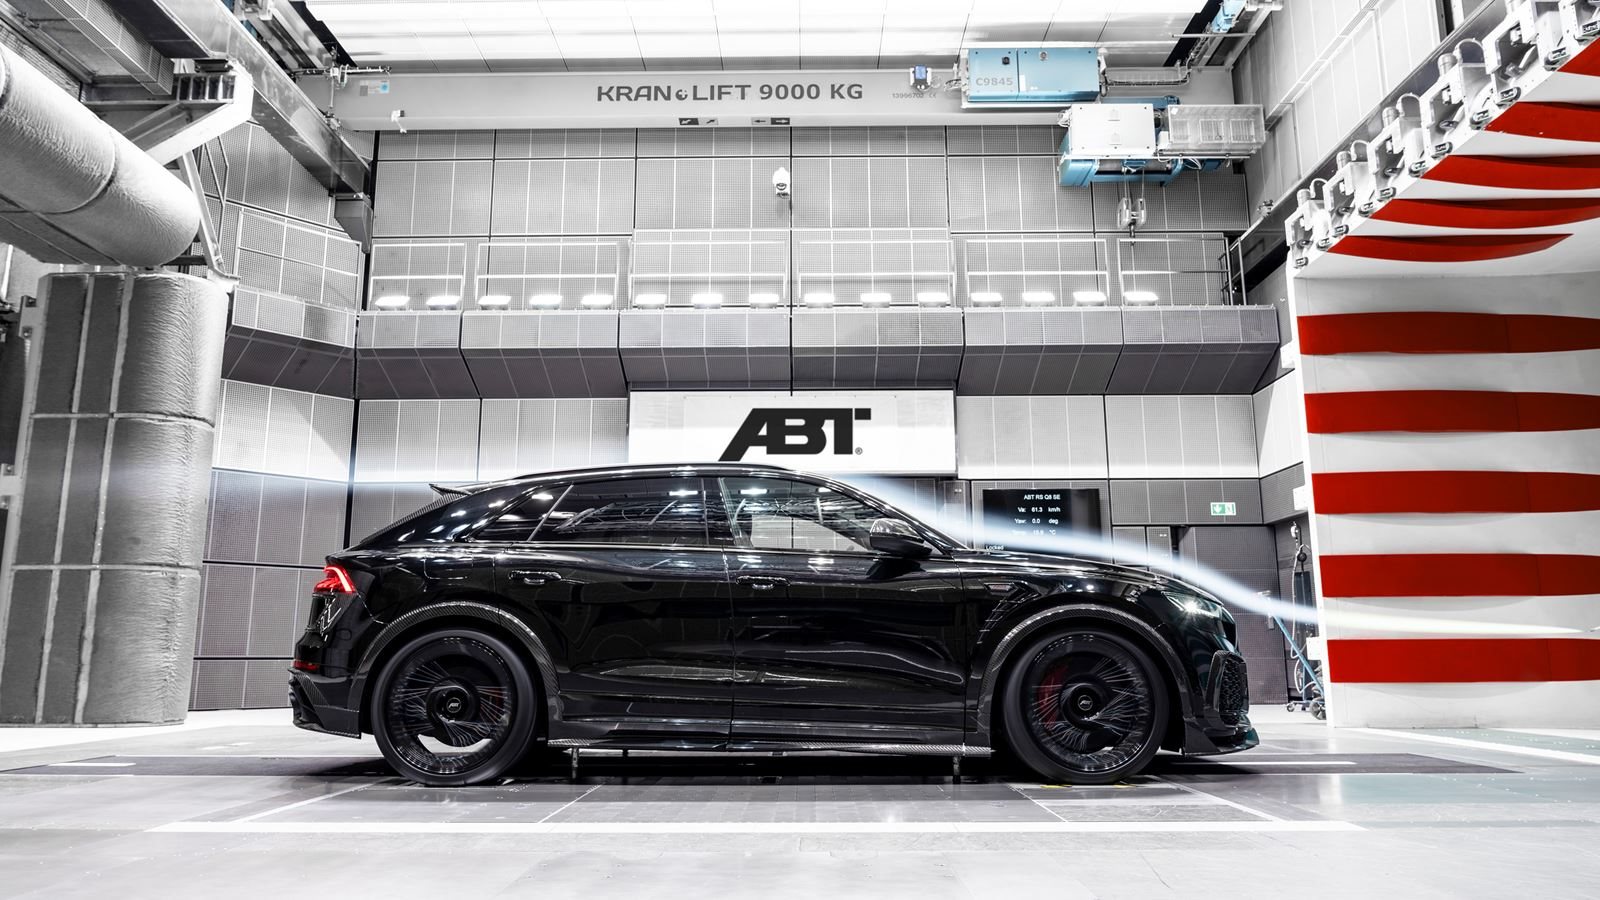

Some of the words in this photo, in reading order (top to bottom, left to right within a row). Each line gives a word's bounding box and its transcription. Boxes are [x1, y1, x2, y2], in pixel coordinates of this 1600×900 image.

[975, 77, 1014, 86] C9845
[597, 85, 671, 102] KRAN
[692, 84, 752, 101] LIFT
[760, 84, 820, 100] 9000
[830, 83, 863, 99] KG
[718, 408, 871, 462] ABT
